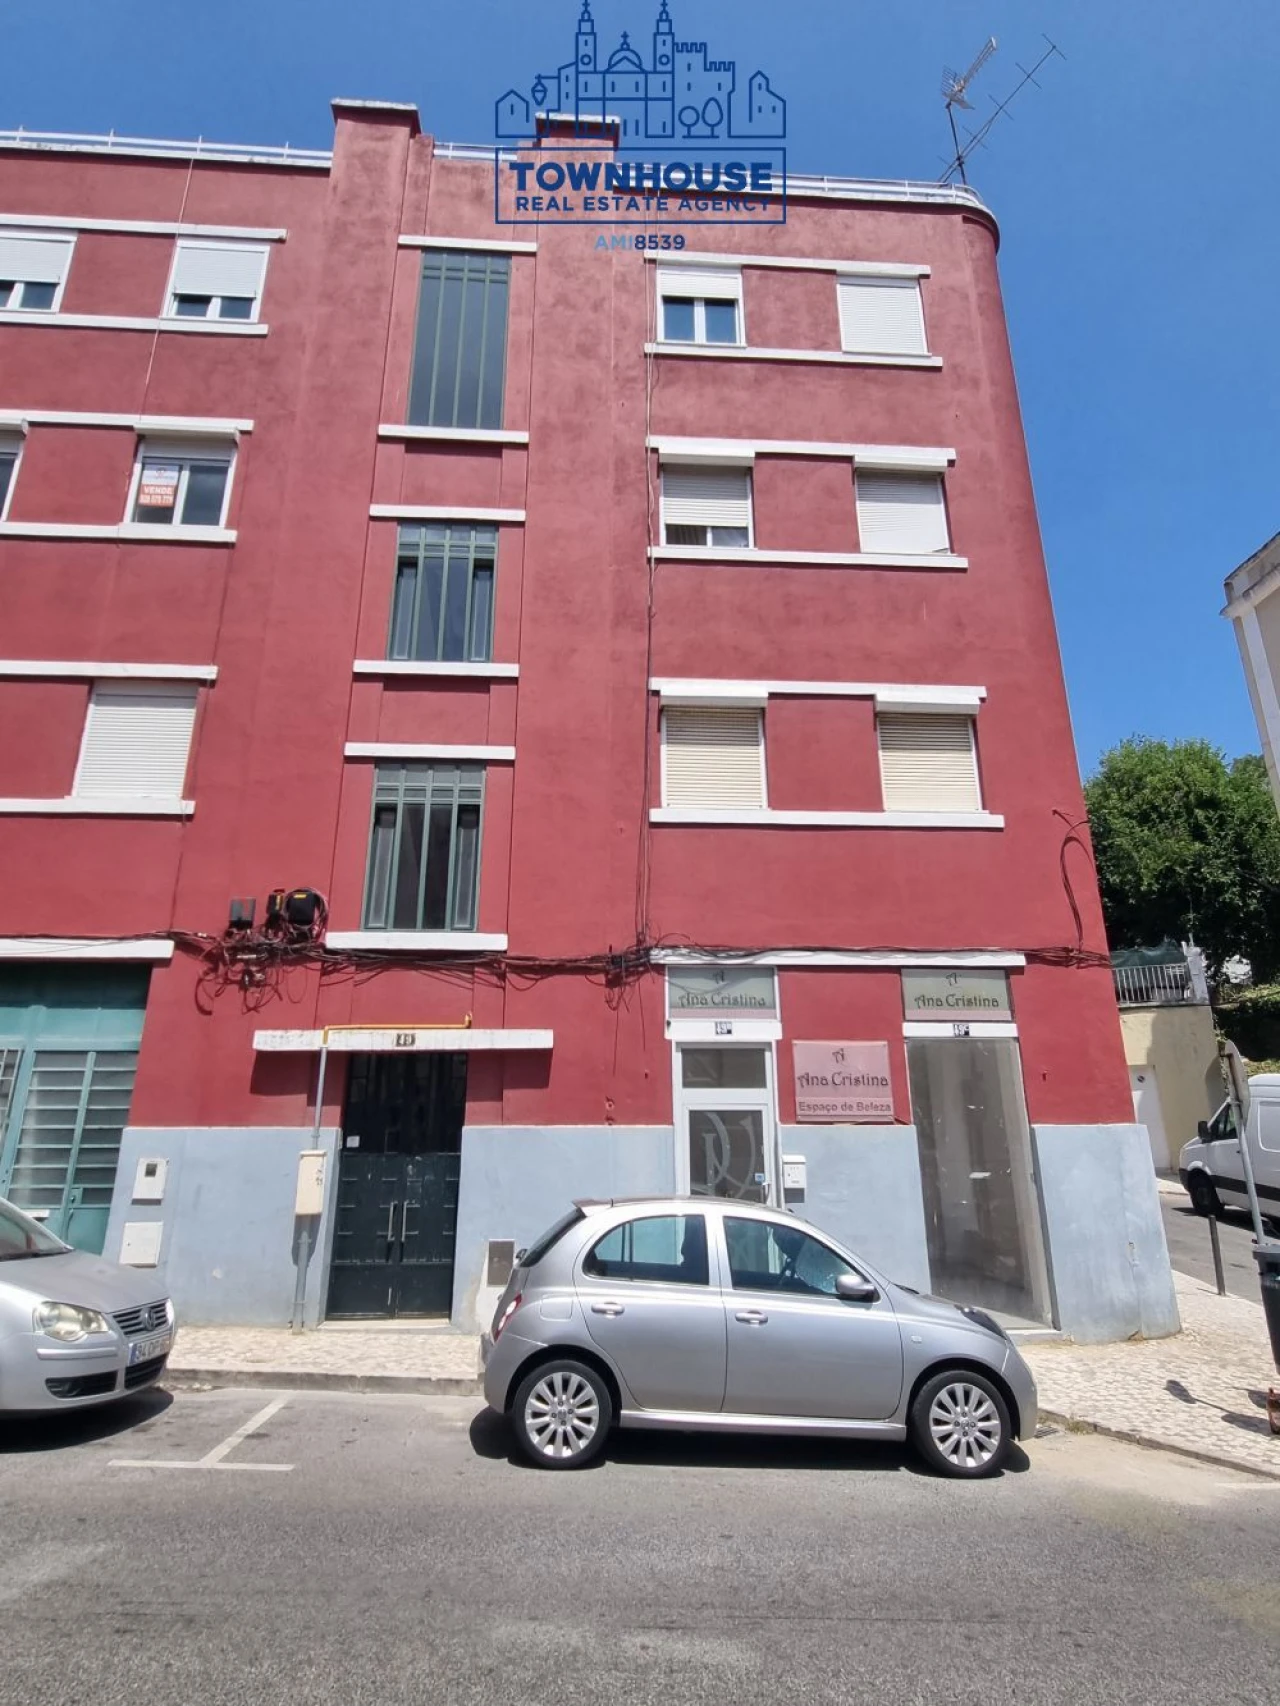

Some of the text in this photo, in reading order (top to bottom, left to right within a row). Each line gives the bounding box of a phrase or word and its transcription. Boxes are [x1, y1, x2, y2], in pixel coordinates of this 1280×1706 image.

[144, 486, 173, 495] VENDE
[678, 991, 766, 1008] Ana Cristina
[914, 993, 999, 1009] Ana Cristina
[797, 1071, 889, 1088] Ana Cristina
[798, 1101, 892, 1113] Espaço de Beleza
